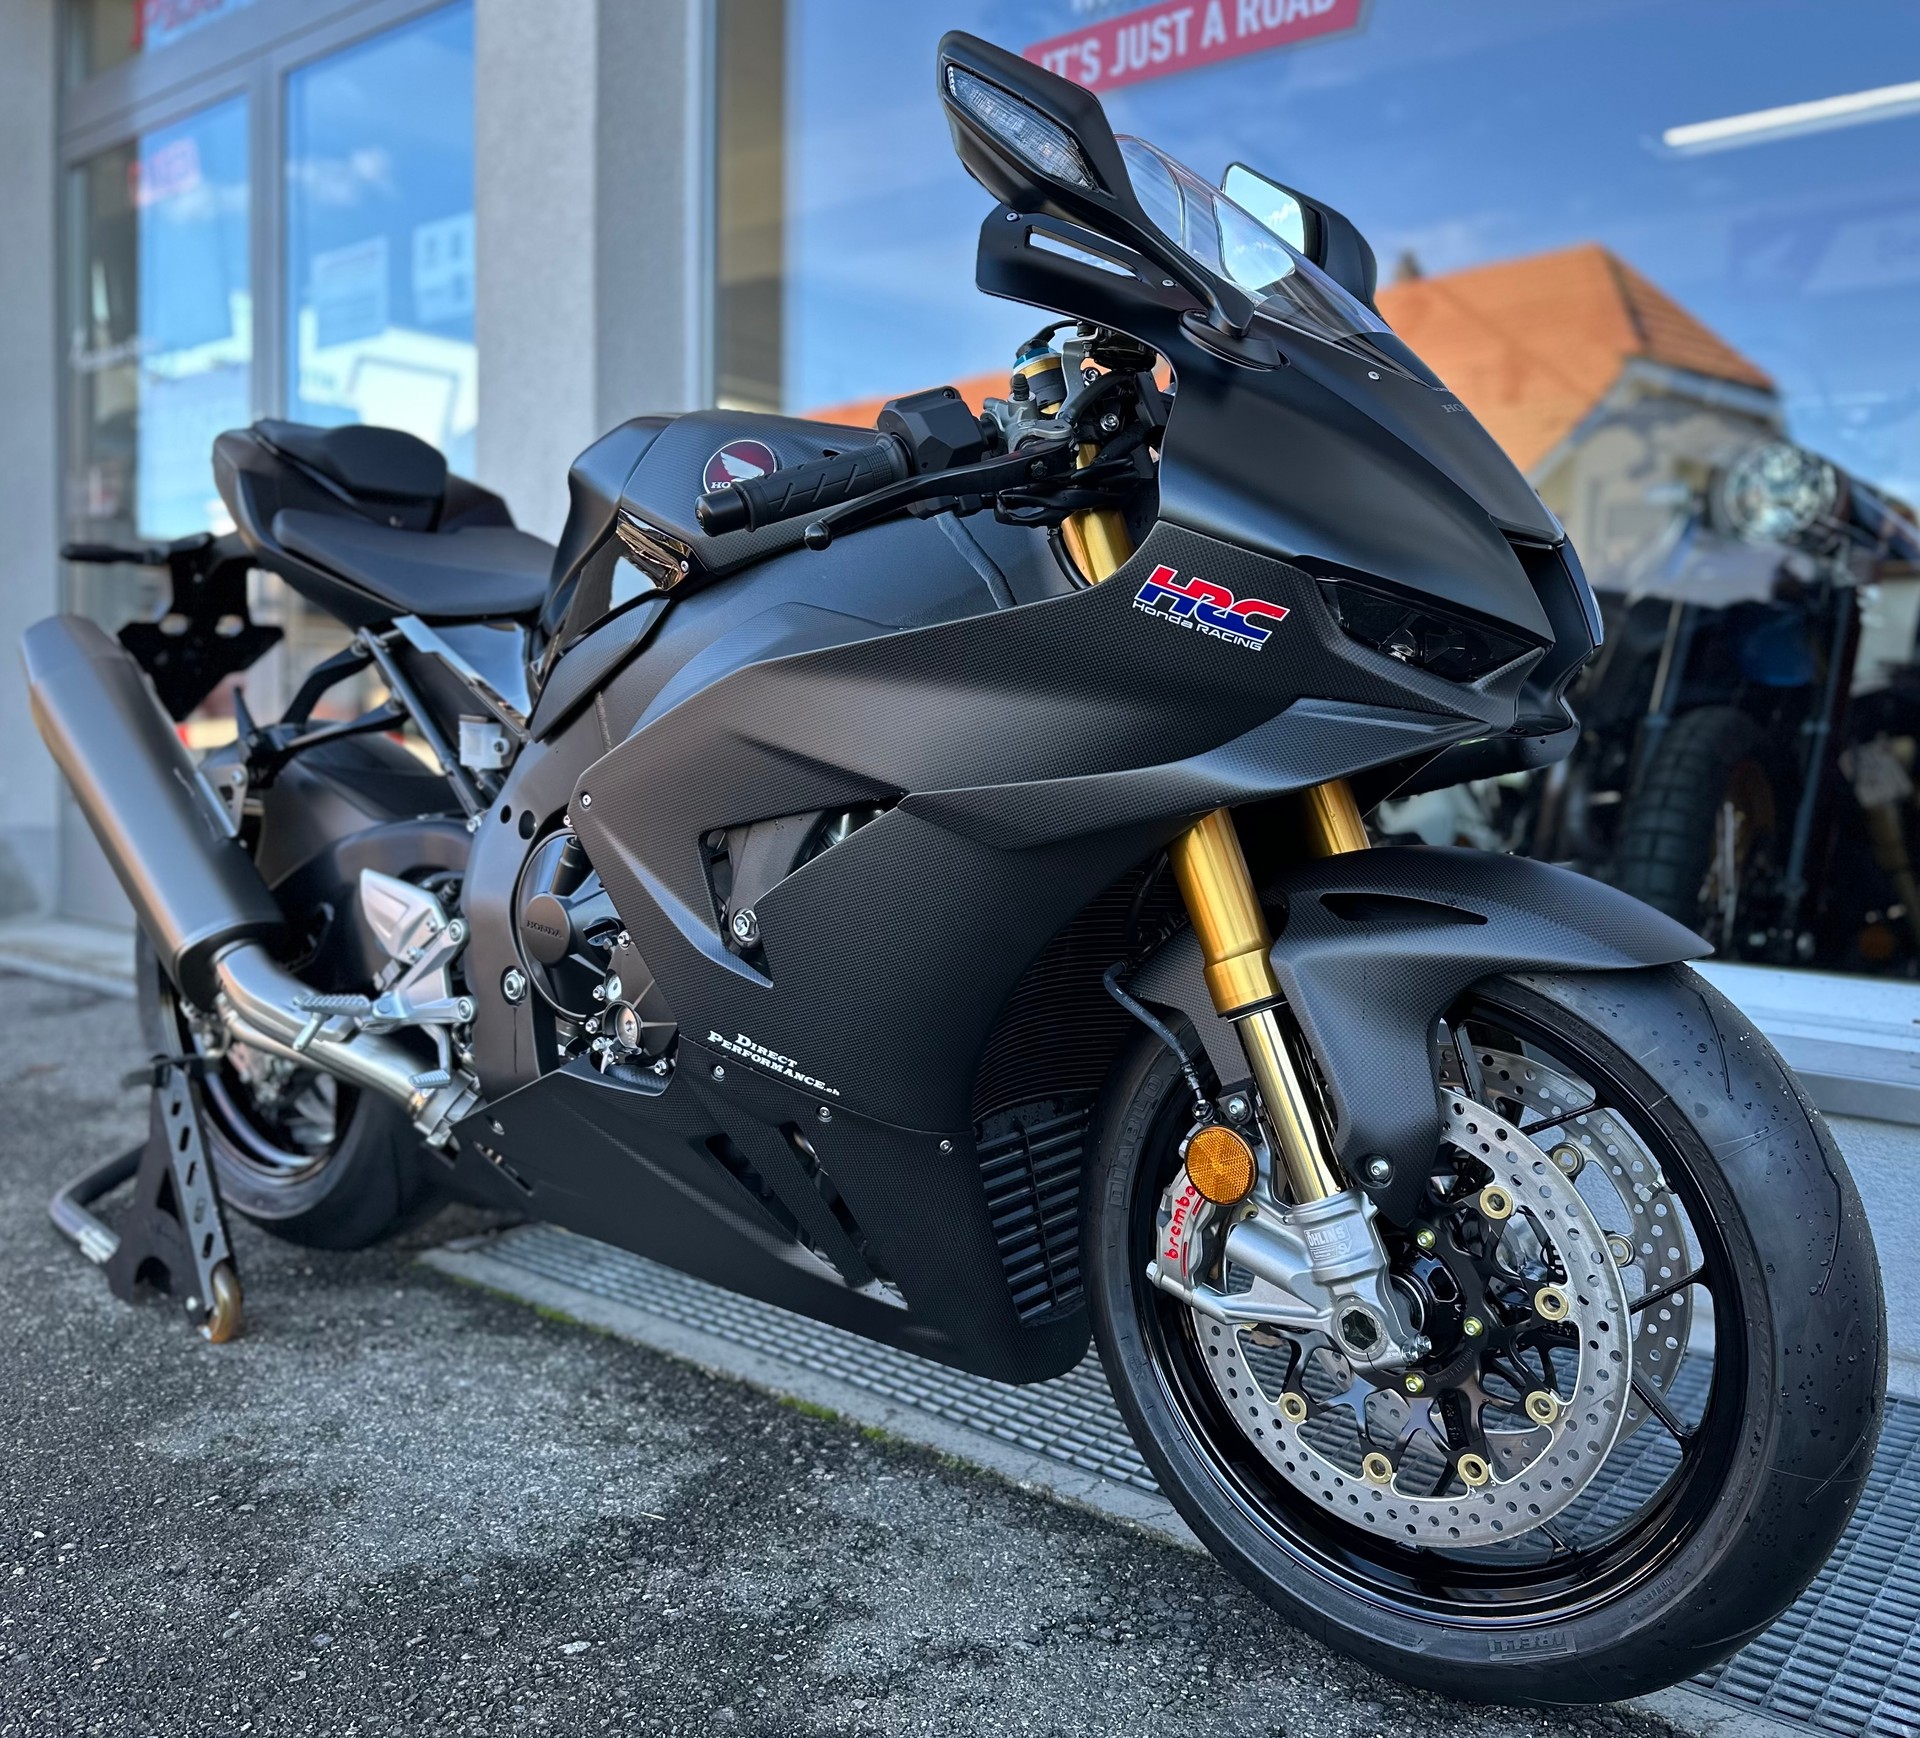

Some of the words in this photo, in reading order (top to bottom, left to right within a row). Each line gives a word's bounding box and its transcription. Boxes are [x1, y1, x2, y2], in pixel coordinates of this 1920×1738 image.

[1109, 7, 1193, 76] JUST
[1201, 0, 1226, 48] A
[1132, 600, 1193, 629] Honda
[1196, 623, 1263, 651] RACING
[1135, 564, 1290, 643] HRC
[735, 1033, 798, 1068] DIRECT
[1109, 1073, 1163, 1205] DIABLO
[1163, 1185, 1196, 1260] brembo
